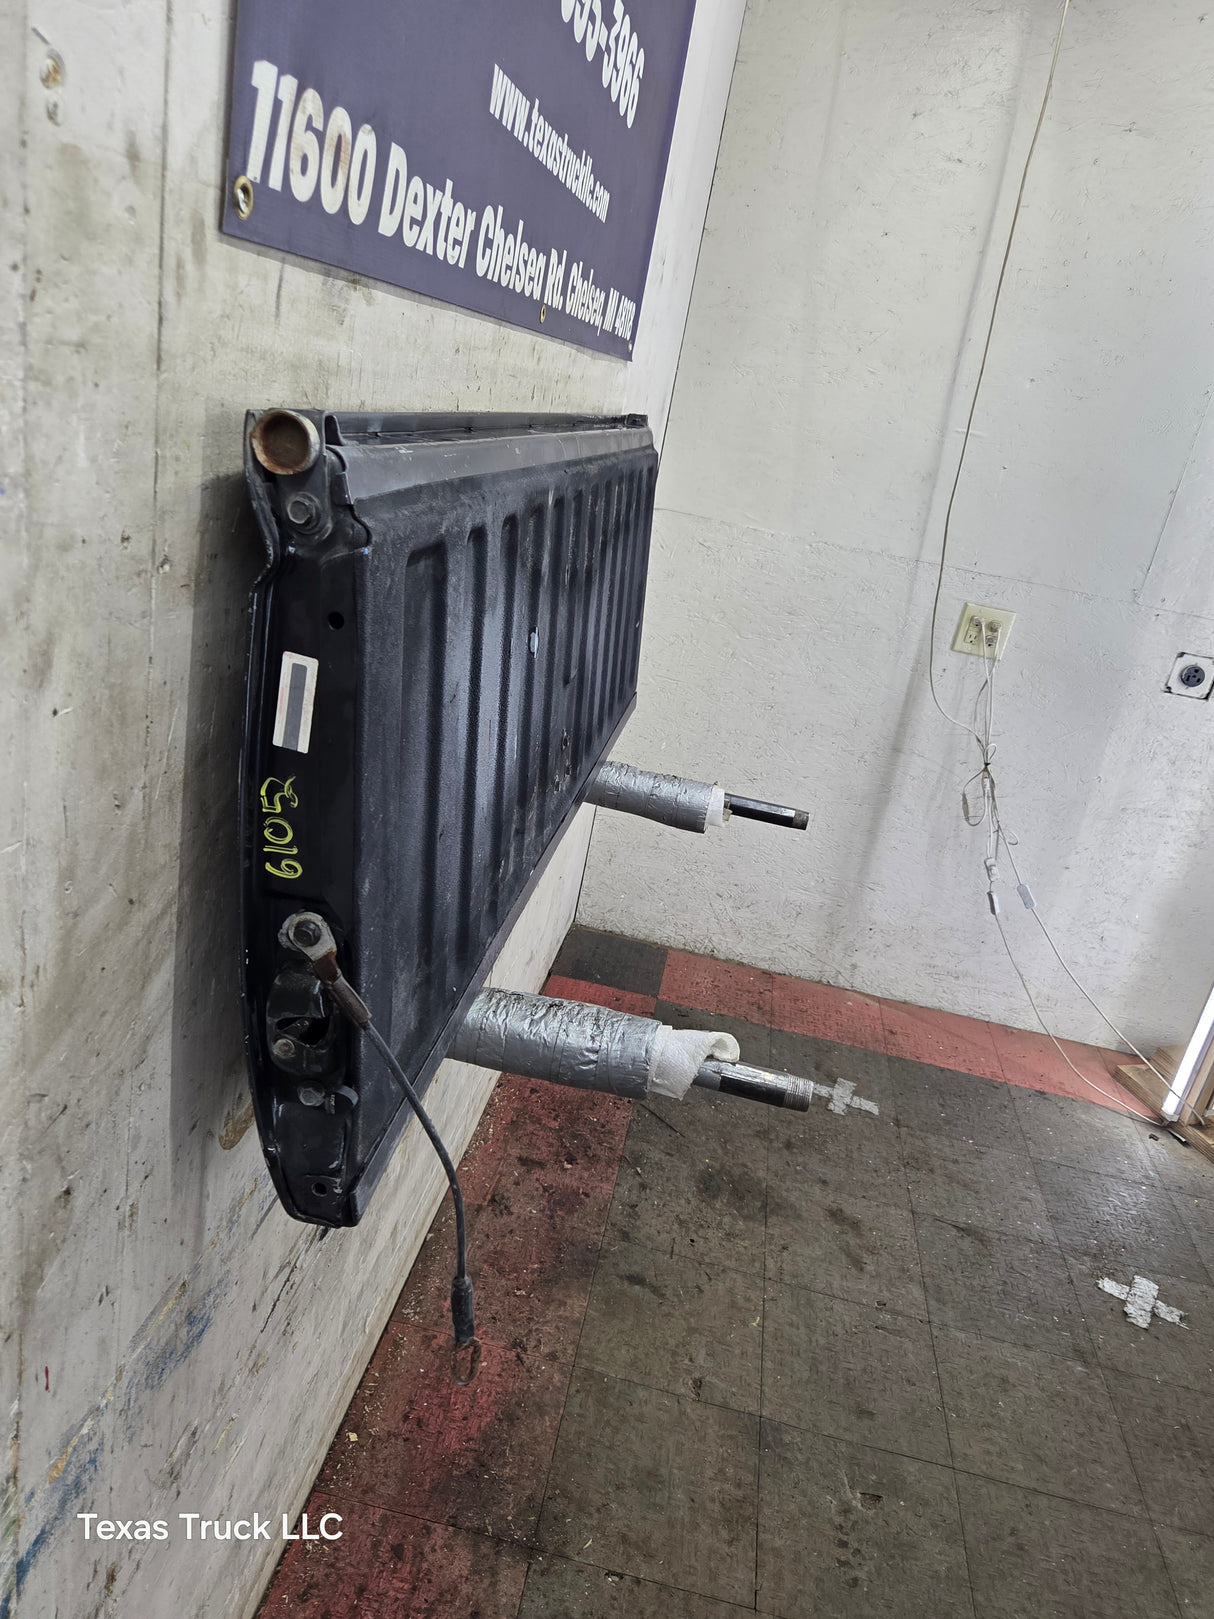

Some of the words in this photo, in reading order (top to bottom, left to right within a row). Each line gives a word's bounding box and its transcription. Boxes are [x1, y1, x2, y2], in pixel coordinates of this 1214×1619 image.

[246, 60, 377, 225] 11600
[378, 141, 476, 269] Dexter
[475, 204, 546, 301] Chelsea
[544, 247, 568, 311] Rd.
[565, 260, 606, 337] Chelsea,
[602, 287, 620, 333] MI
[490, 63, 610, 223] www.texastruckllc.com
[260, 776, 303, 879] 61052
